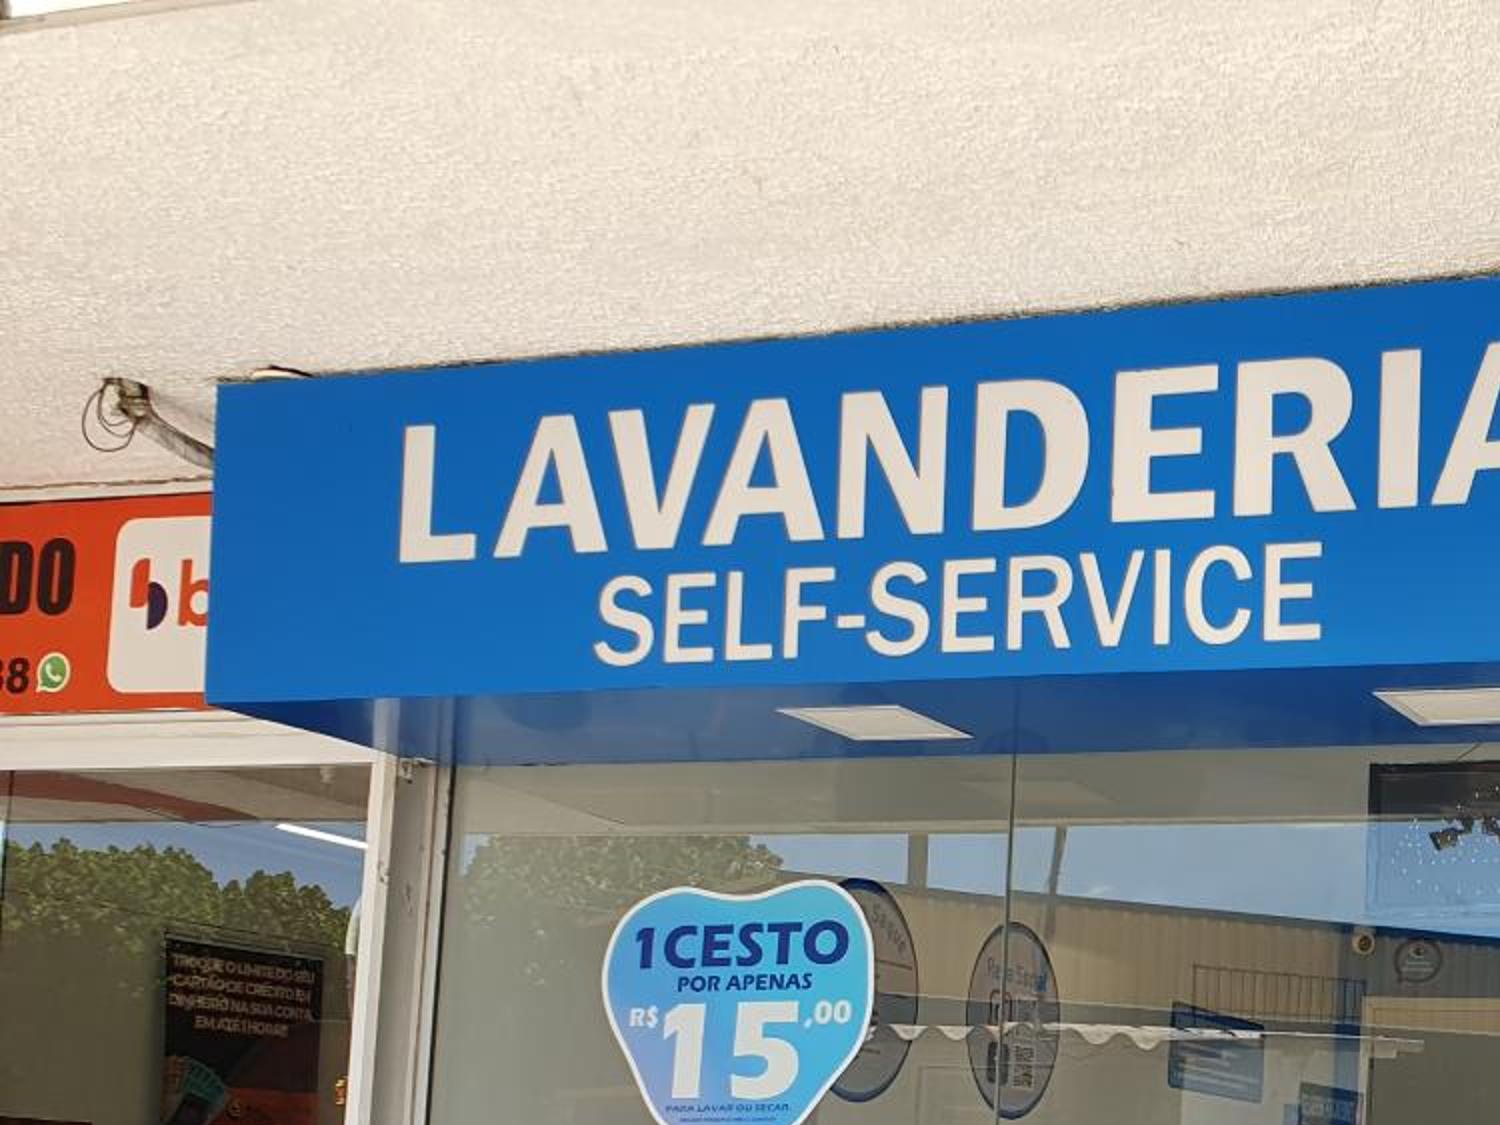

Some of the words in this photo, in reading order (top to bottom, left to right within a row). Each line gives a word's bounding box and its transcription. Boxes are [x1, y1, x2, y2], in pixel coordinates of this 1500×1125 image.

[593, 538, 1323, 668] SELF-SERVICE
[677, 975, 720, 993] POR
[725, 972, 813, 992] APENAS
